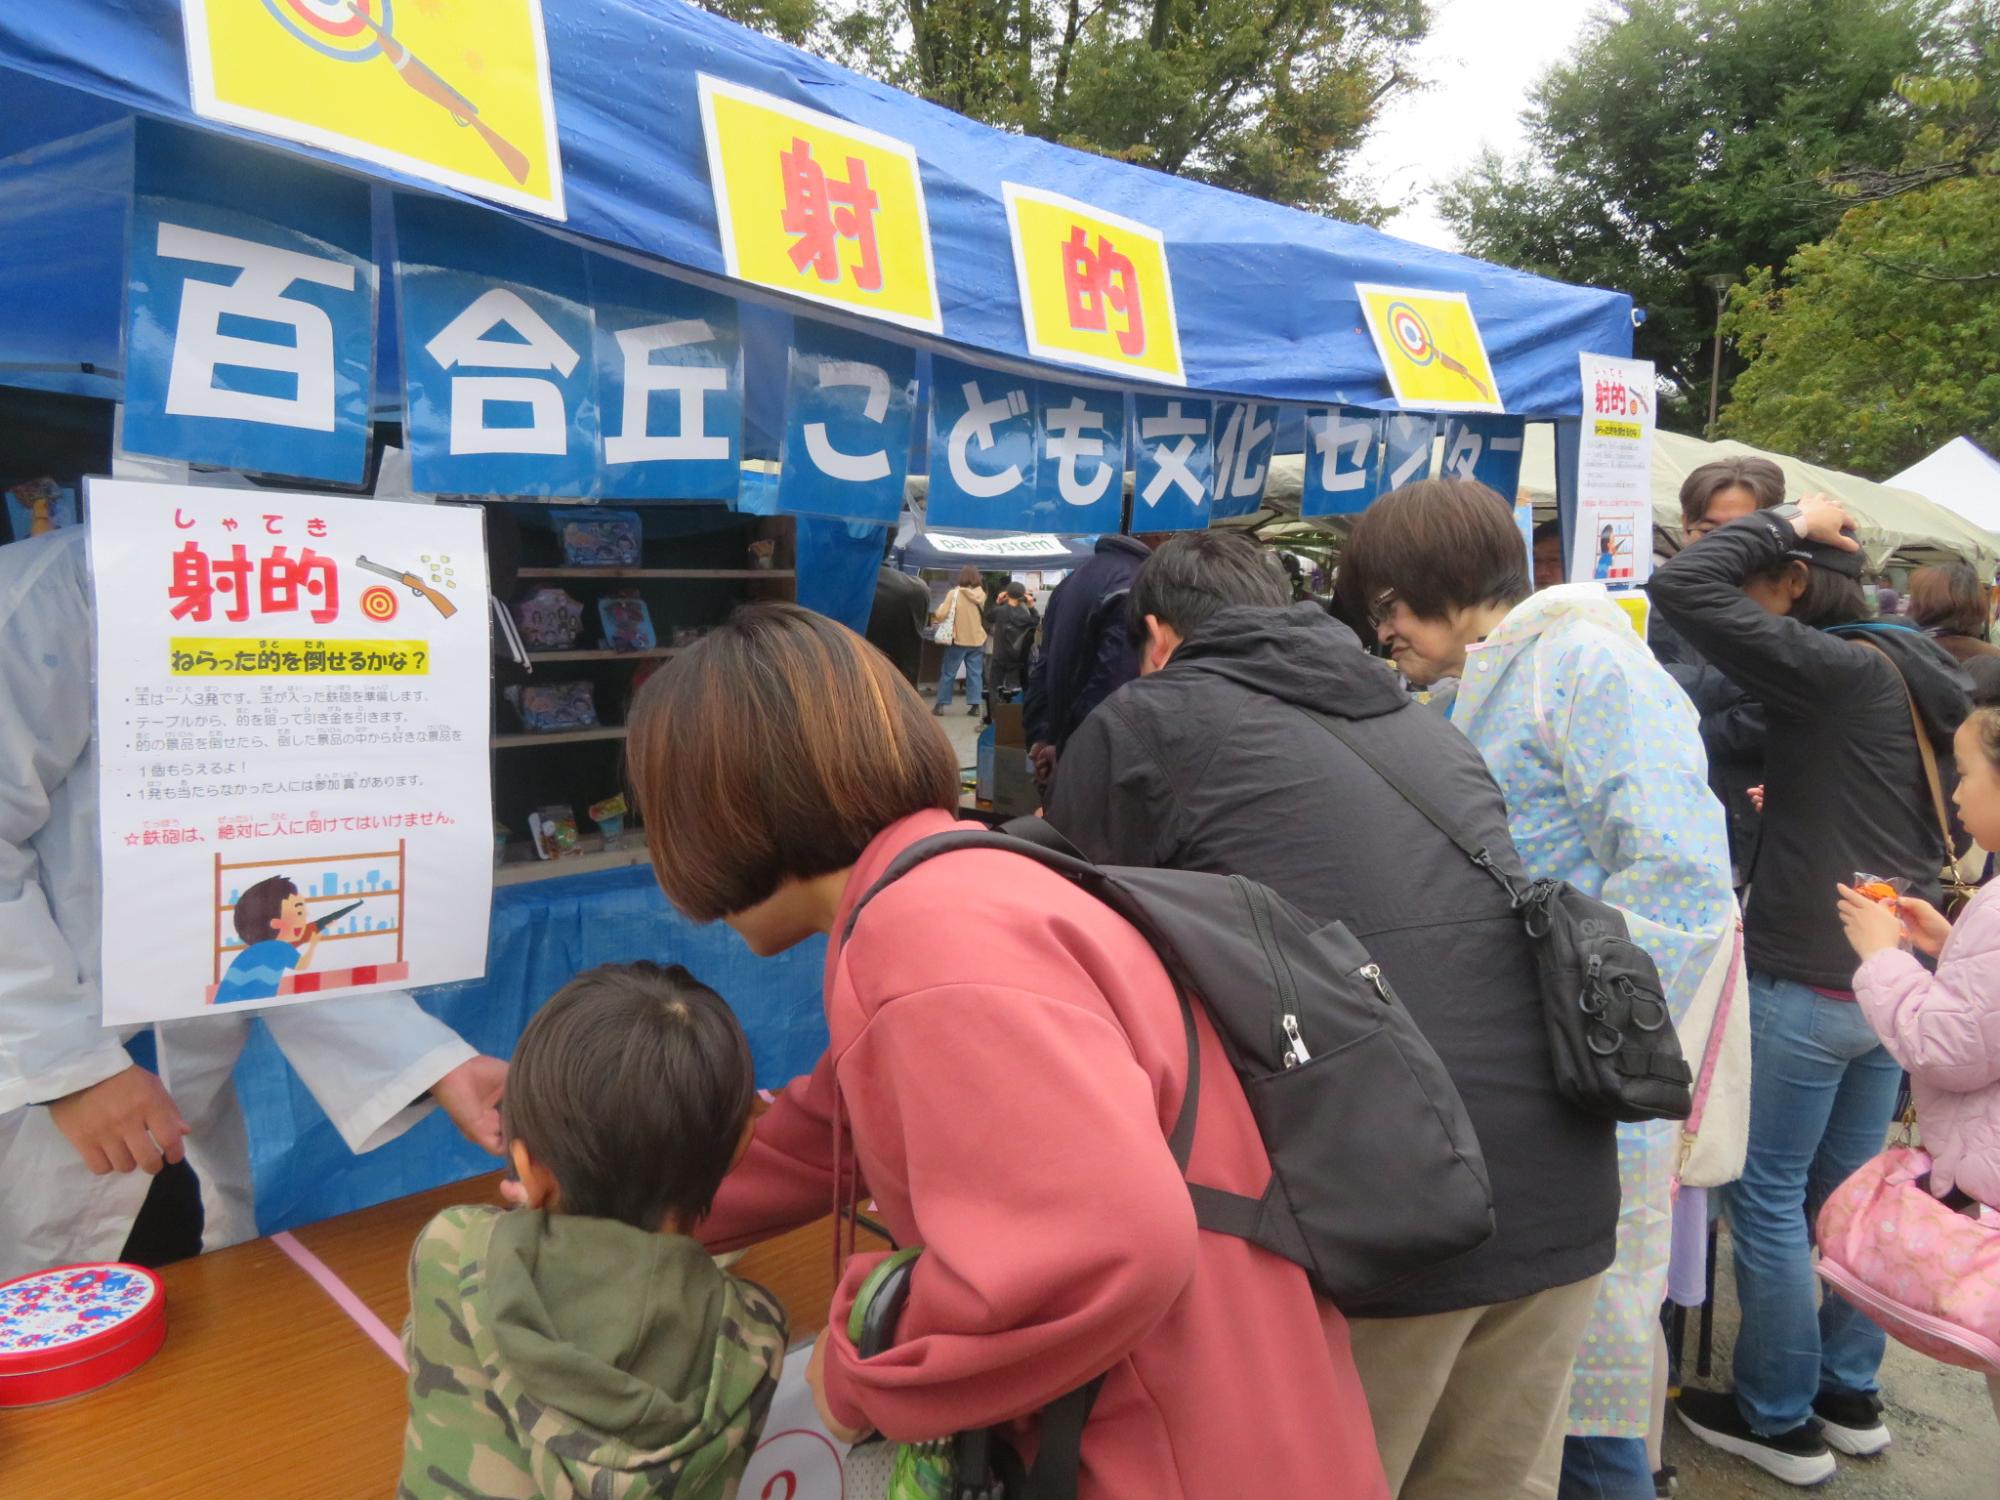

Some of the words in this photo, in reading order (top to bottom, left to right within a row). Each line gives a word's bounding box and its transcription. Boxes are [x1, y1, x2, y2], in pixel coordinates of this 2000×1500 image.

[1595, 379, 1626, 416] 射的
[174, 508, 328, 538] しゃてき
[168, 541, 339, 624] 射的
[172, 650, 426, 672] ねらった的を倒せるかな？
